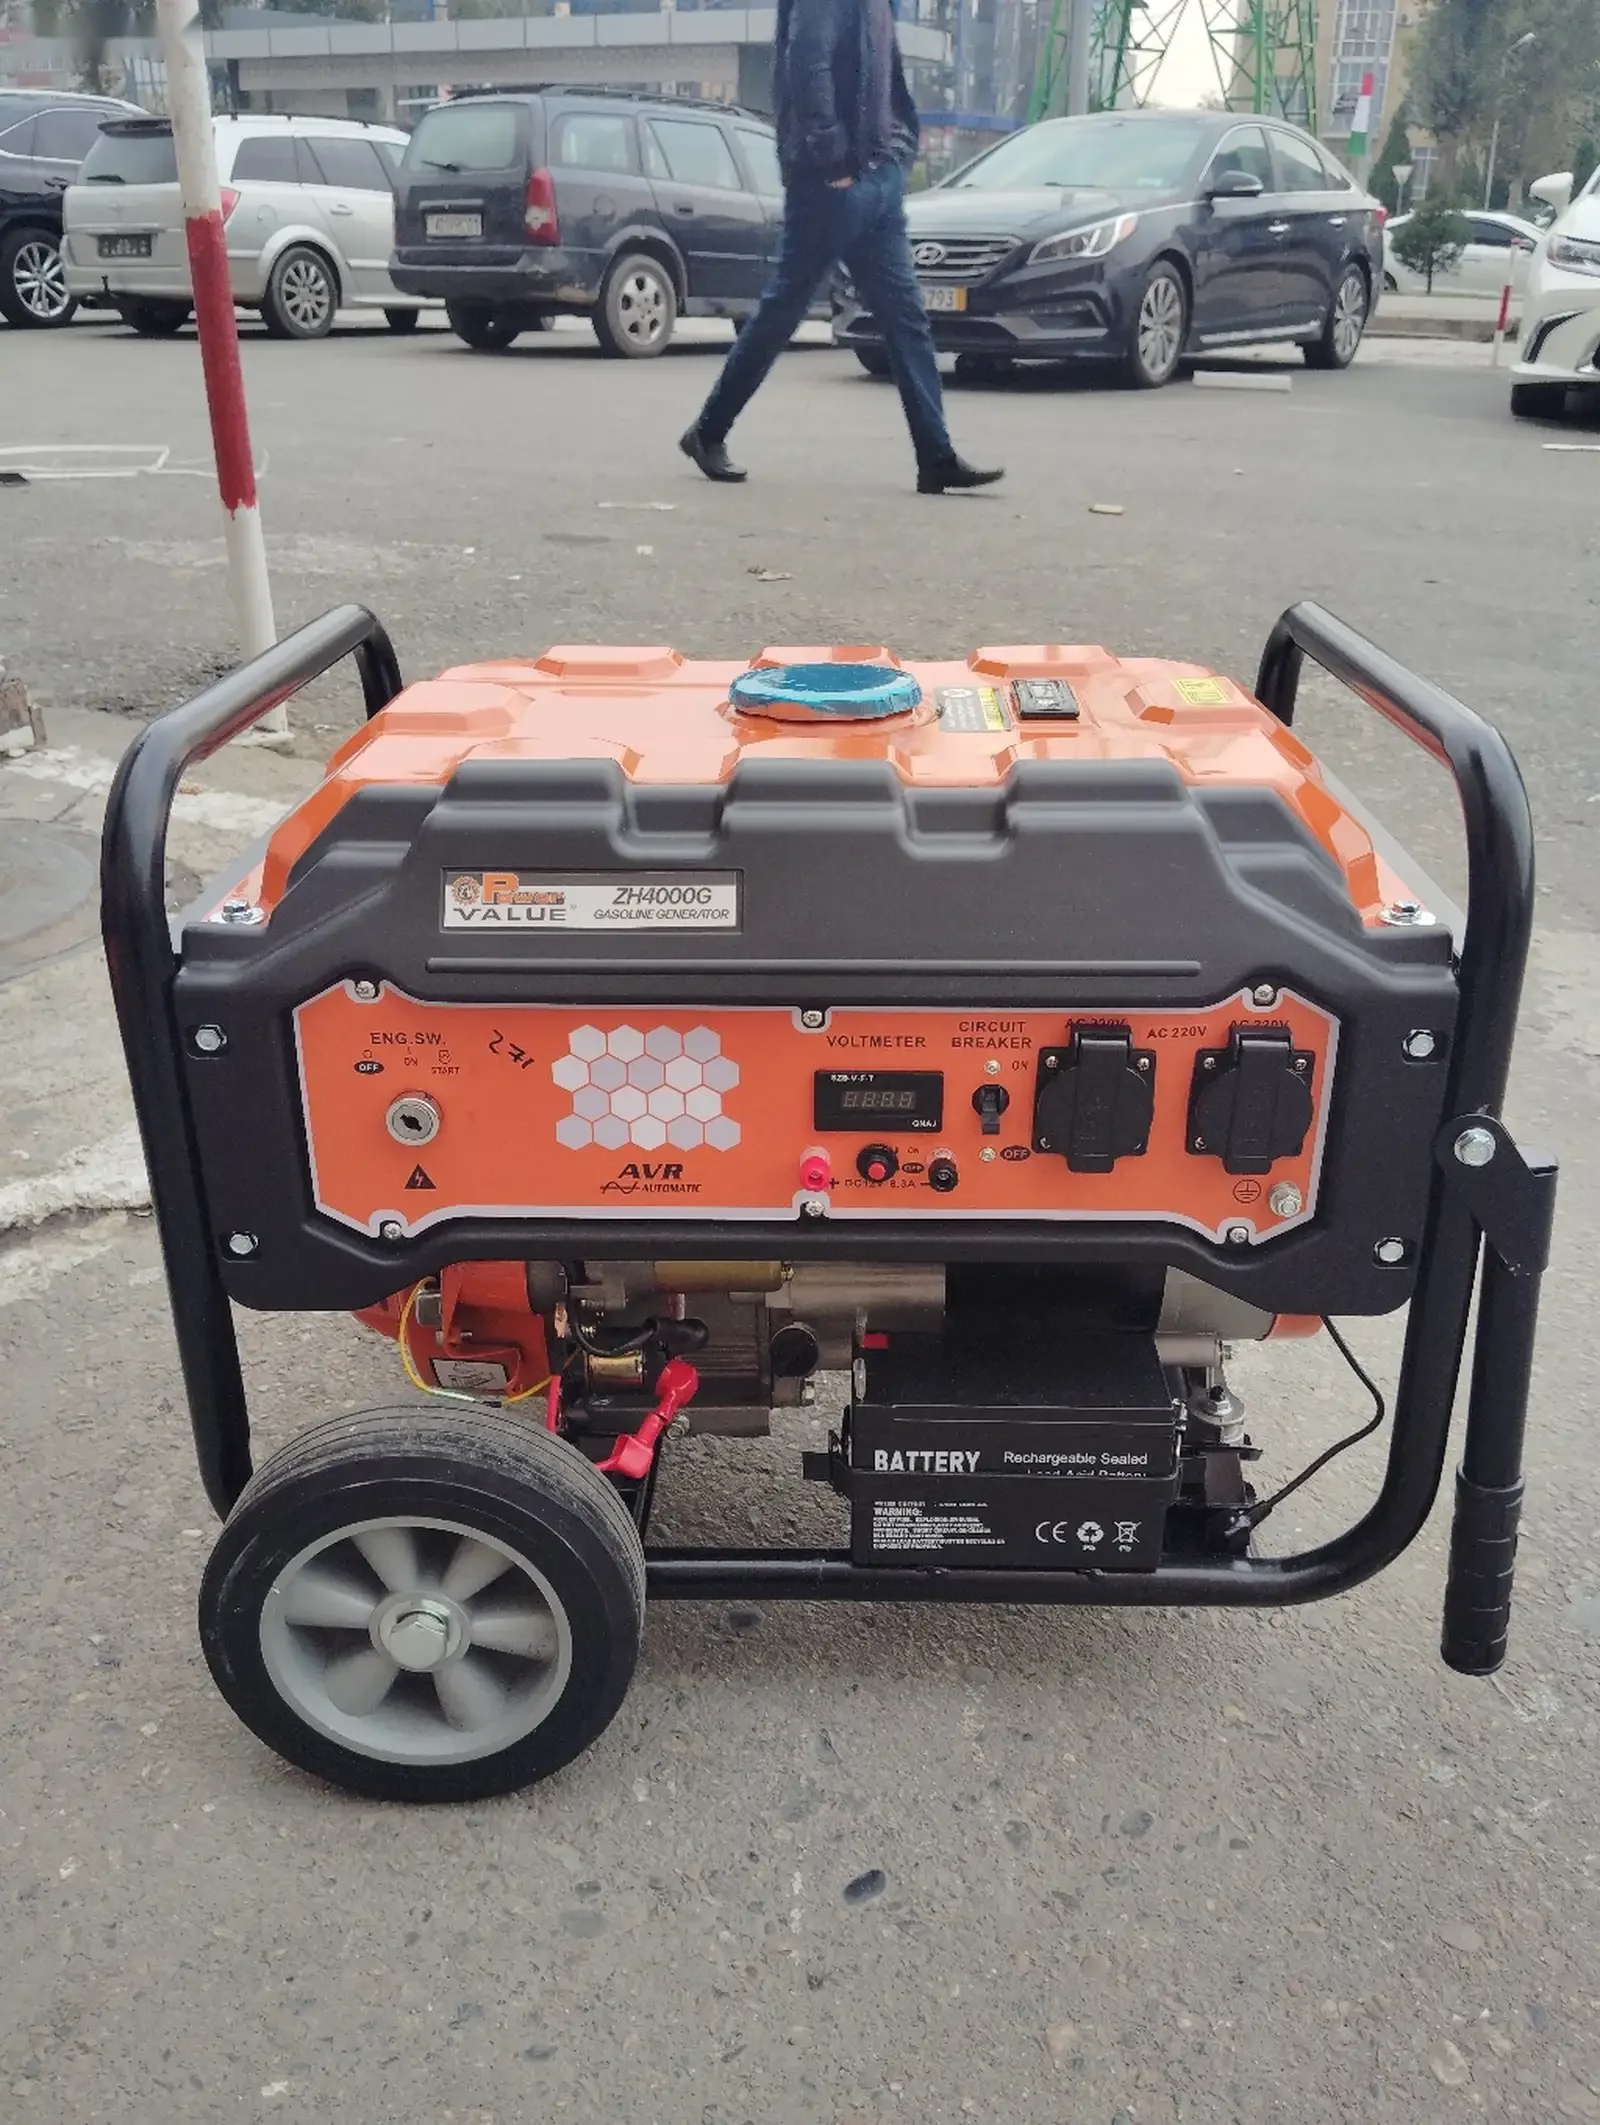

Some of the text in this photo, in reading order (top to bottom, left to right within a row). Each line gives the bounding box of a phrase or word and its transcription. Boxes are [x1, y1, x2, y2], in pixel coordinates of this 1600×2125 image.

[612, 887, 712, 905] ZH4000G
[453, 908, 566, 921] VALUE
[593, 909, 730, 920] GASOLINE GENERATOR
[958, 1021, 1027, 1033] CIRCUIT
[1146, 1025, 1207, 1040] AC 220V
[370, 1032, 447, 1045] ENG.SW.
[826, 1035, 926, 1048] VOLTMETER
[951, 1036, 1032, 1049] BREAKER
[359, 1063, 379, 1072] OFF
[431, 1066, 460, 1075] START
[1011, 1060, 1028, 1071] ON
[1003, 1149, 1028, 1158] OFF
[618, 1163, 684, 1179] AVR
[642, 1183, 701, 1193] AUTOMATIC
[890, 1179, 917, 1189] 8.3A
[874, 1449, 981, 1473] BATTERY
[1003, 1450, 1148, 1467] Rechargeable Sealed
